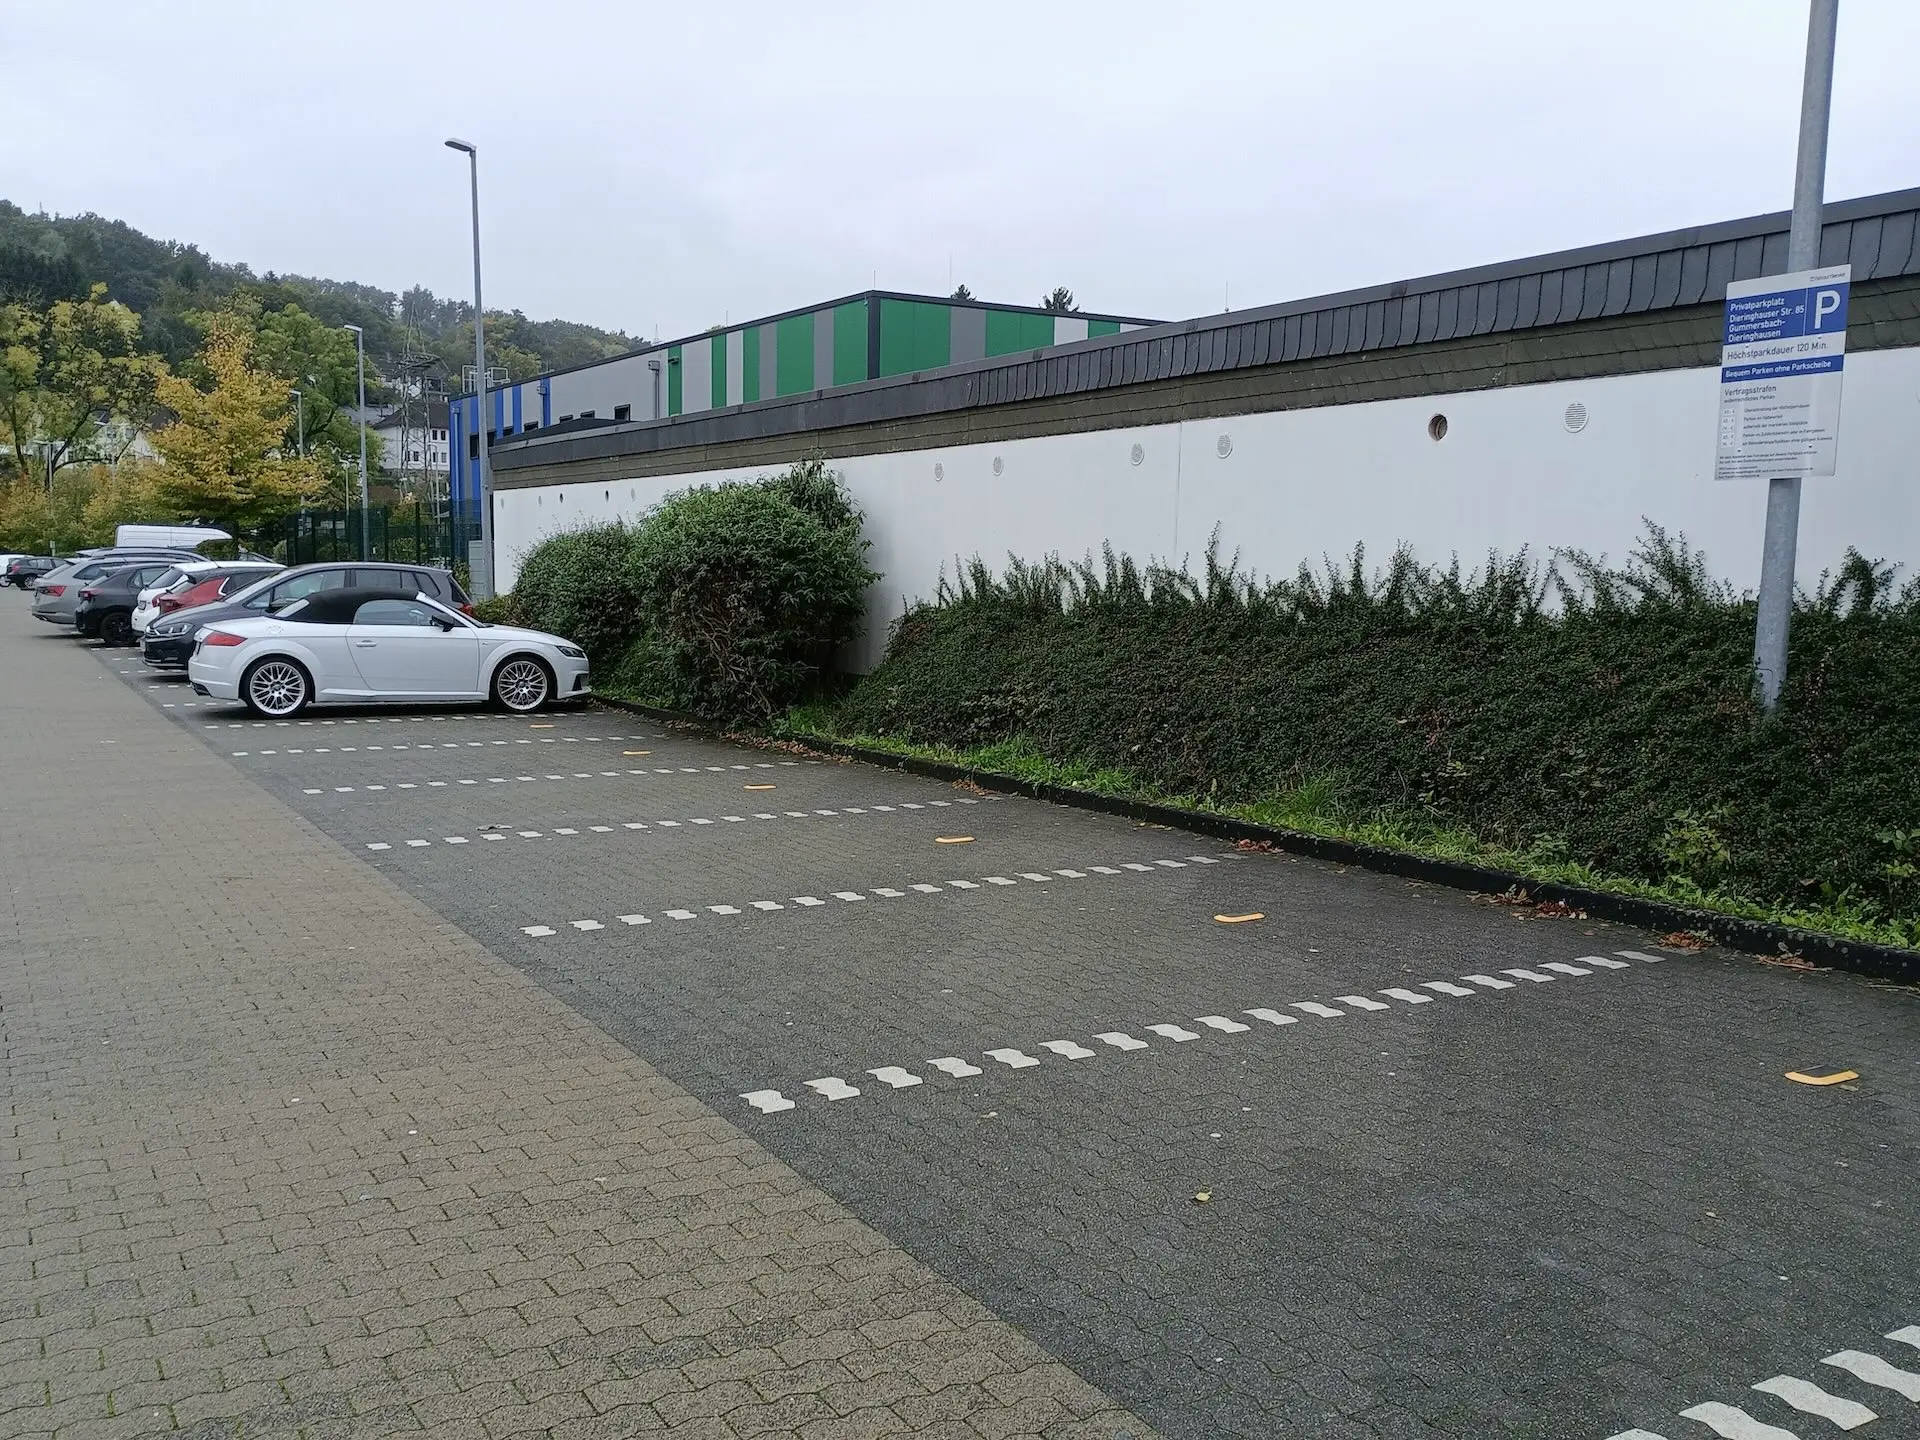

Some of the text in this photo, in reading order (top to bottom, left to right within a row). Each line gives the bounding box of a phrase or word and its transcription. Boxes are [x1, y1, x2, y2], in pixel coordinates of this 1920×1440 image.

[1730, 298, 1784, 312] Privatparkplatz
[1814, 290, 1840, 329] P
[1730, 305, 1804, 322] Dieringhauser Str. 85
[1728, 319, 1786, 332] Gummersbach-
[1728, 329, 1781, 342] Dieringhausen
[1727, 342, 1828, 360] Höchstparkdauer 120 Min.
[1726, 369, 1750, 379] Bequem
[1752, 366, 1774, 375] Parken
[1792, 360, 1832, 370] Parkscheibe
[1724, 385, 1776, 396] Vertragsstrafen
